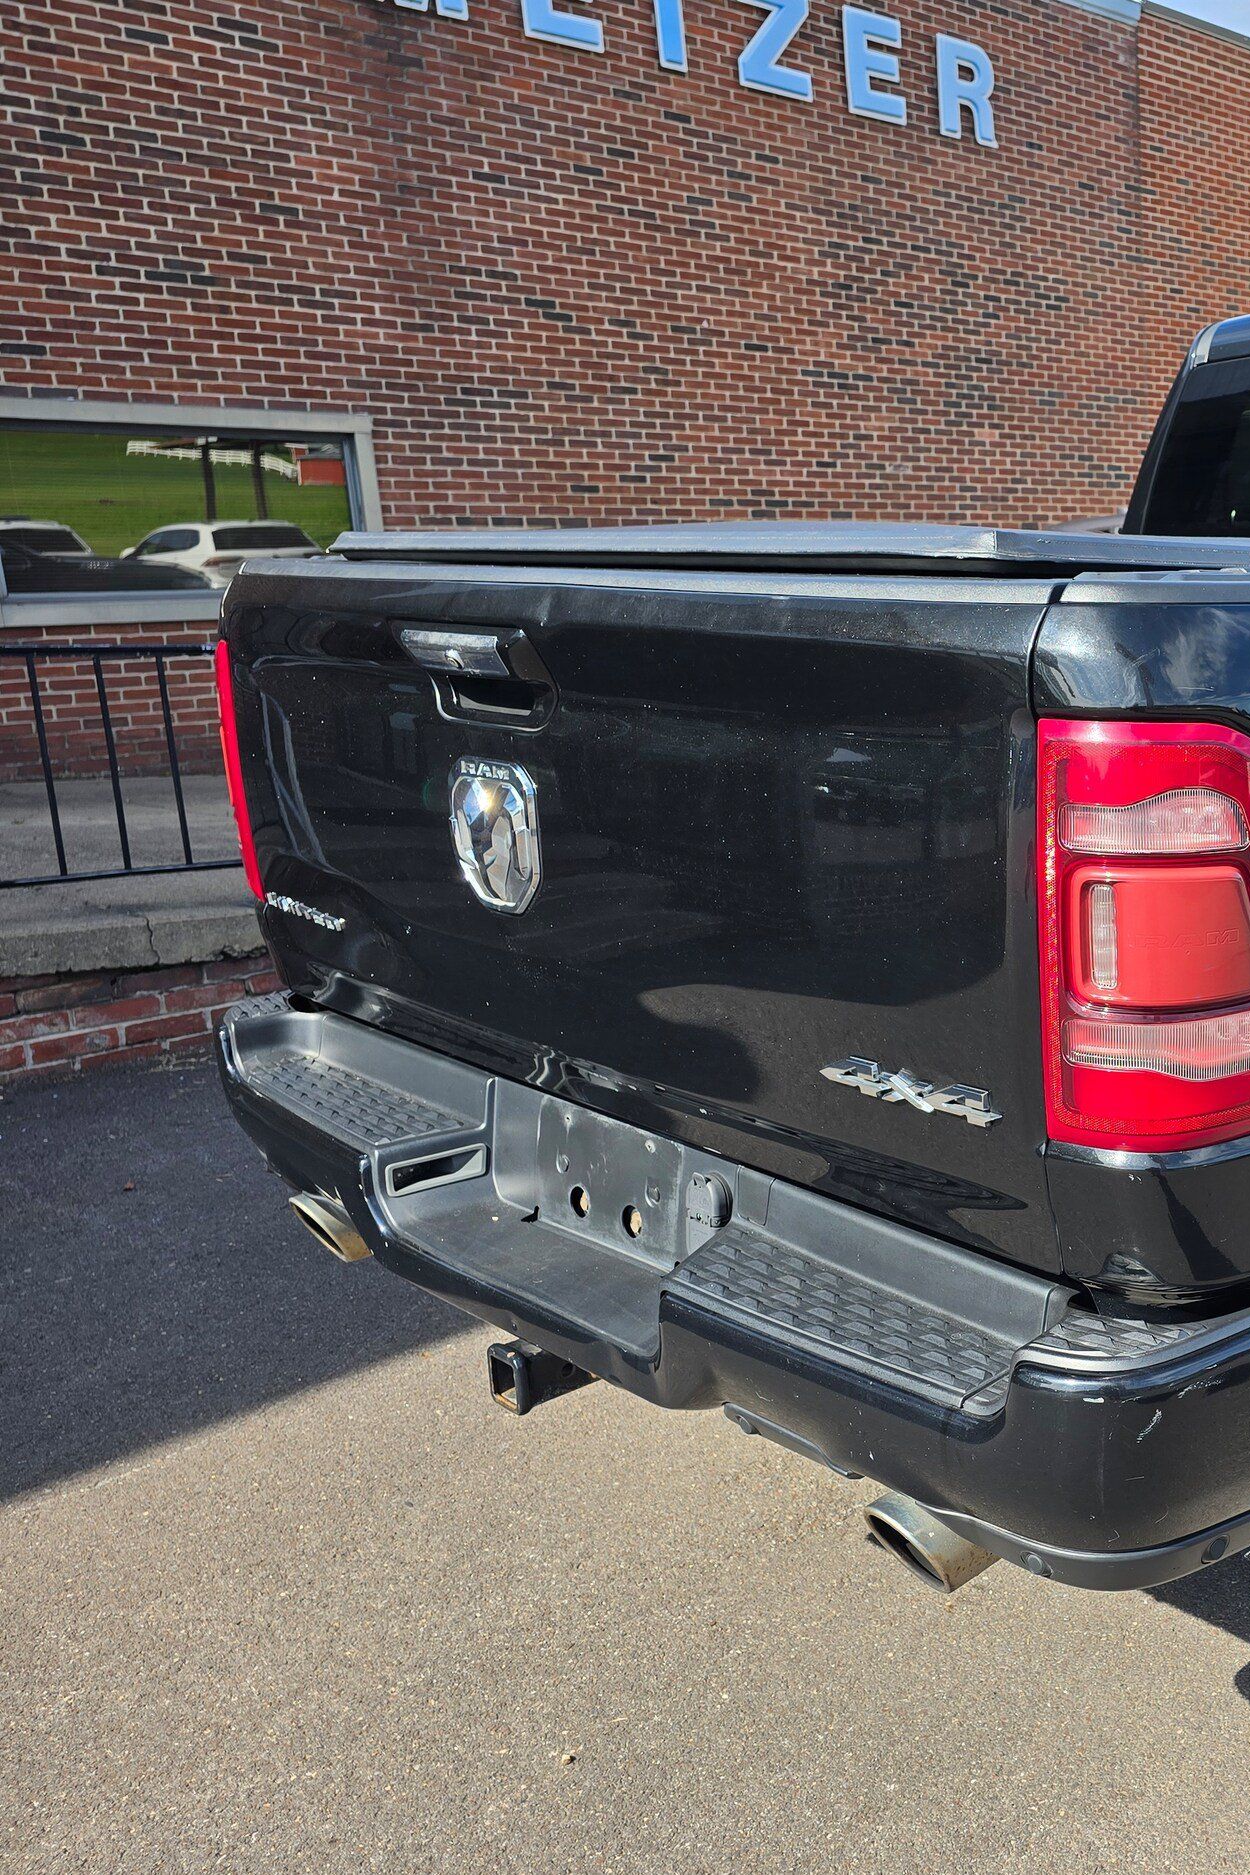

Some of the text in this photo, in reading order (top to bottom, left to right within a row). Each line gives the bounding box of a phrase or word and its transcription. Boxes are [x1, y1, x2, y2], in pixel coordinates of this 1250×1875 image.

[377, 0, 998, 148] TZER
[460, 760, 510, 780] RAM
[1133, 928, 1240, 950] RAM
